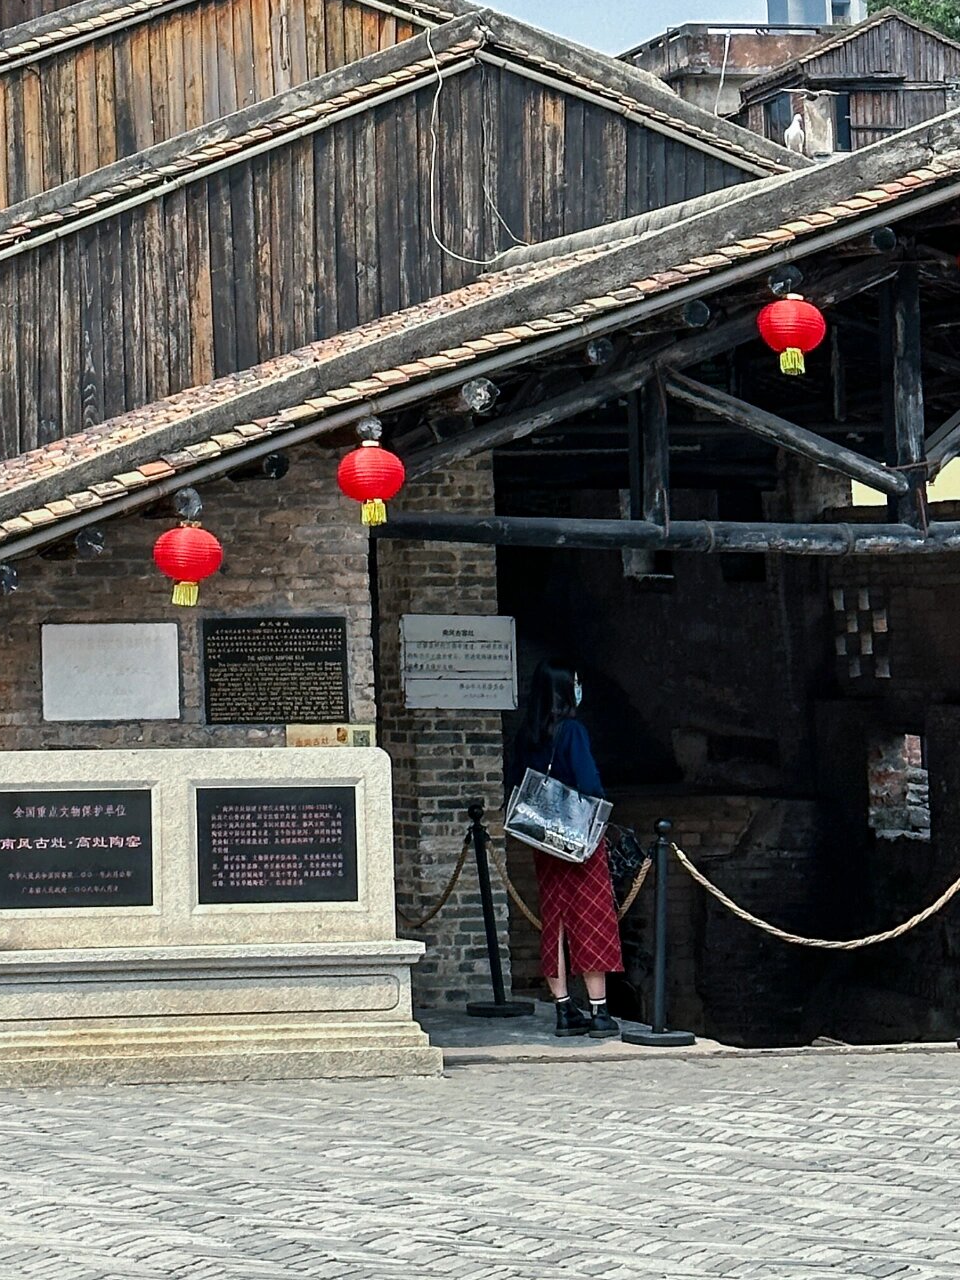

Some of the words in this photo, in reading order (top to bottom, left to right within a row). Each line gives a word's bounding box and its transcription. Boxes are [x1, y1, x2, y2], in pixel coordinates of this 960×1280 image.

[12, 804, 127, 818] 全国重点文物保护单位
